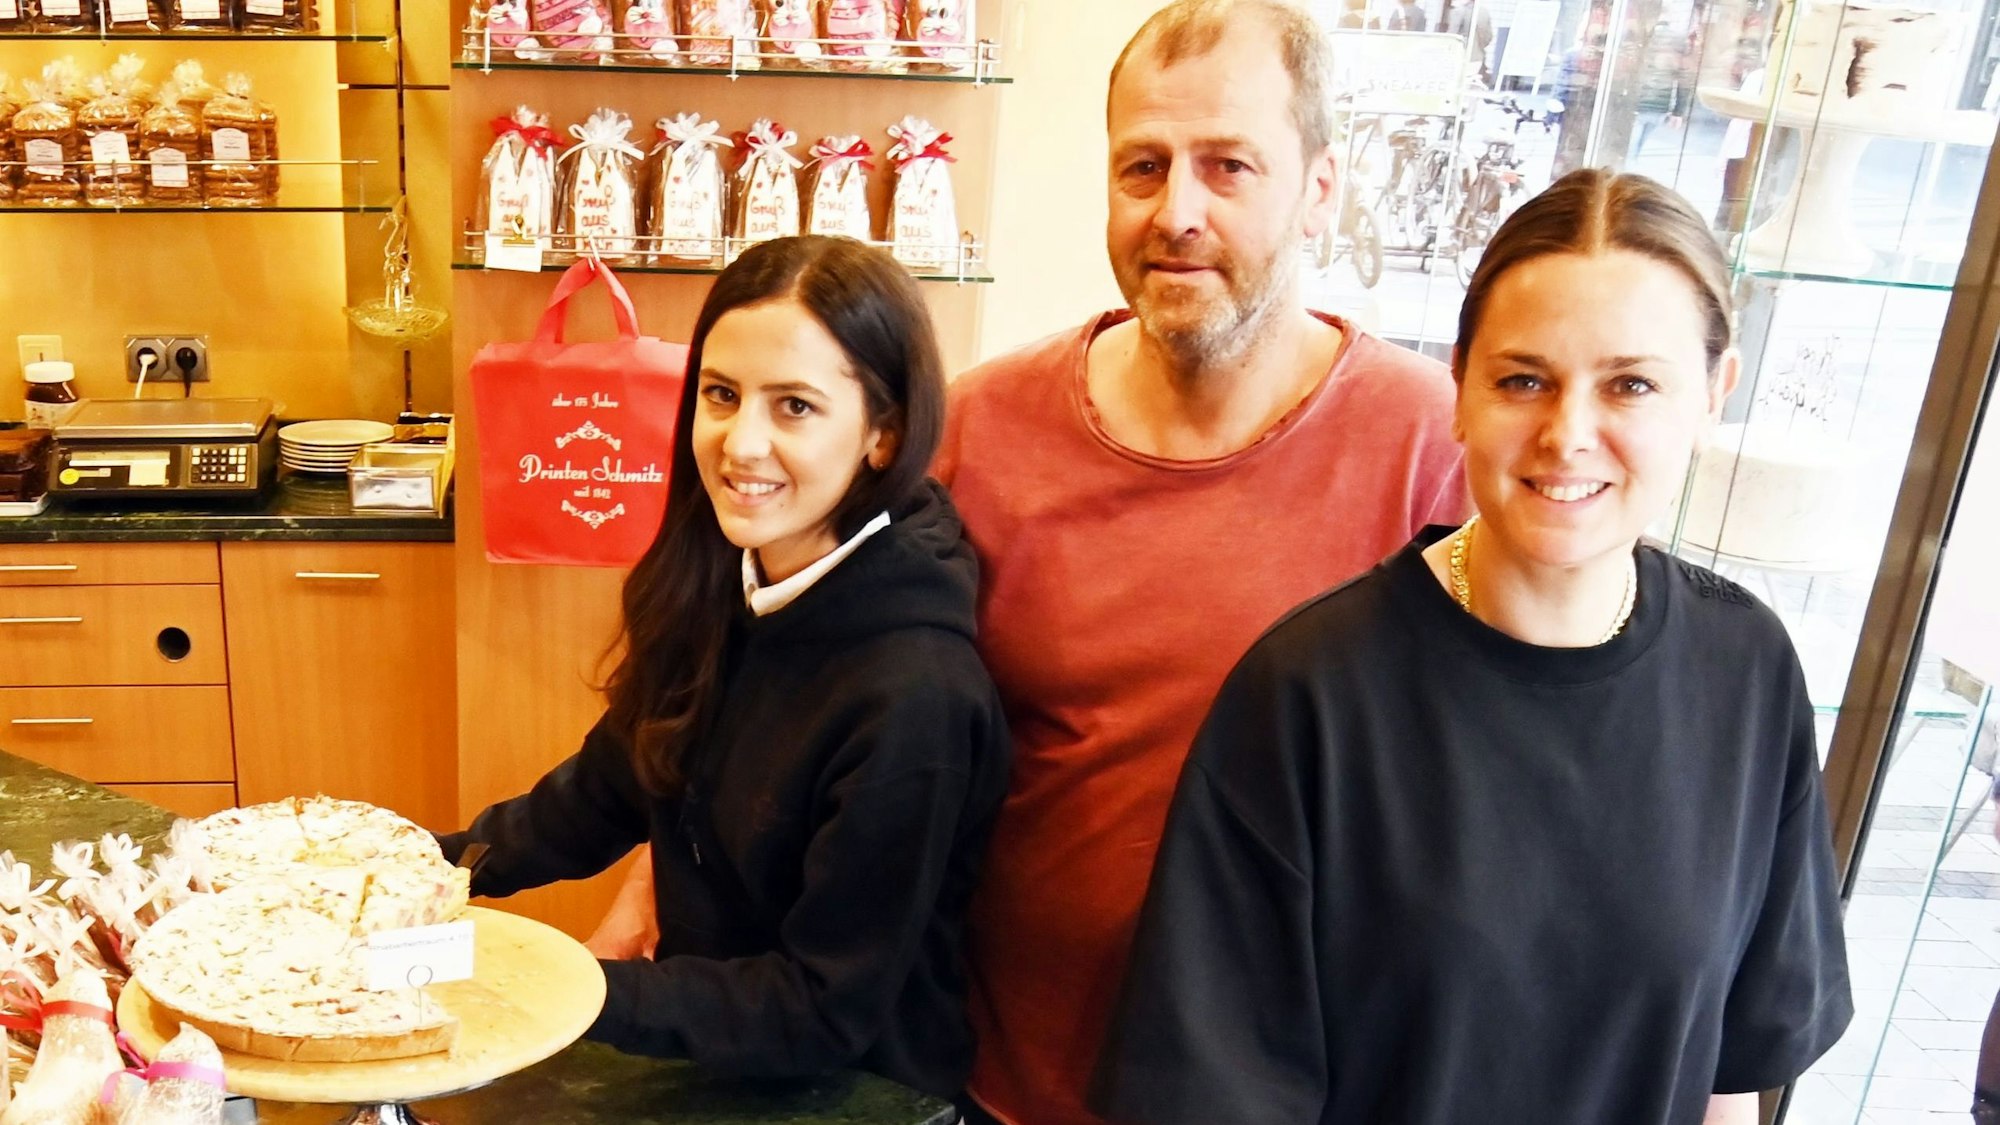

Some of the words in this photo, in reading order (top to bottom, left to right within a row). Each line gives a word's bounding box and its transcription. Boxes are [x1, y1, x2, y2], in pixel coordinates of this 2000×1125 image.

[581, 214, 609, 226] aus
[751, 222, 778, 233] aus
[519, 454, 588, 483] Printen
[591, 456, 663, 483] Schmitz
